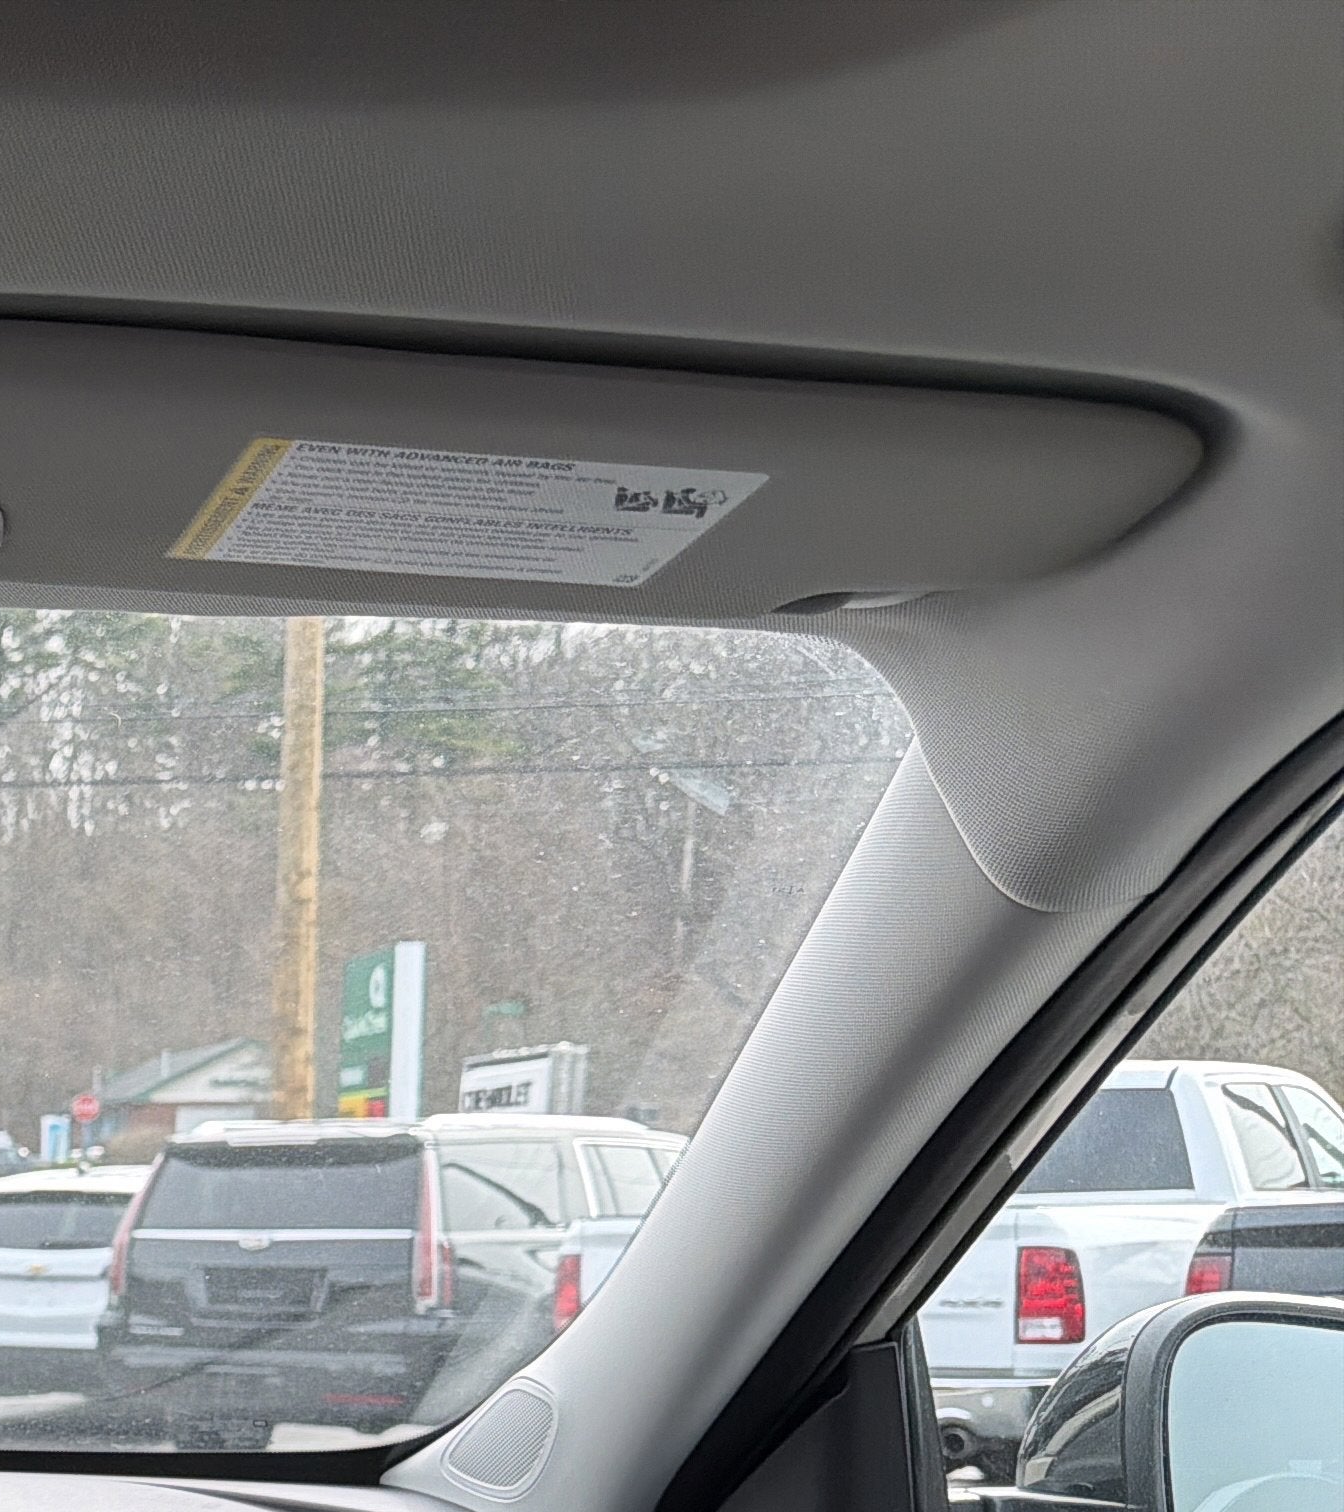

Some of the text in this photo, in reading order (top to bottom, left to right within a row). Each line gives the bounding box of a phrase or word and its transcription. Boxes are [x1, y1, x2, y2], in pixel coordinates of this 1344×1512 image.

[295, 443, 576, 472] EVEN WITH ADVANCED AIR BAGS
